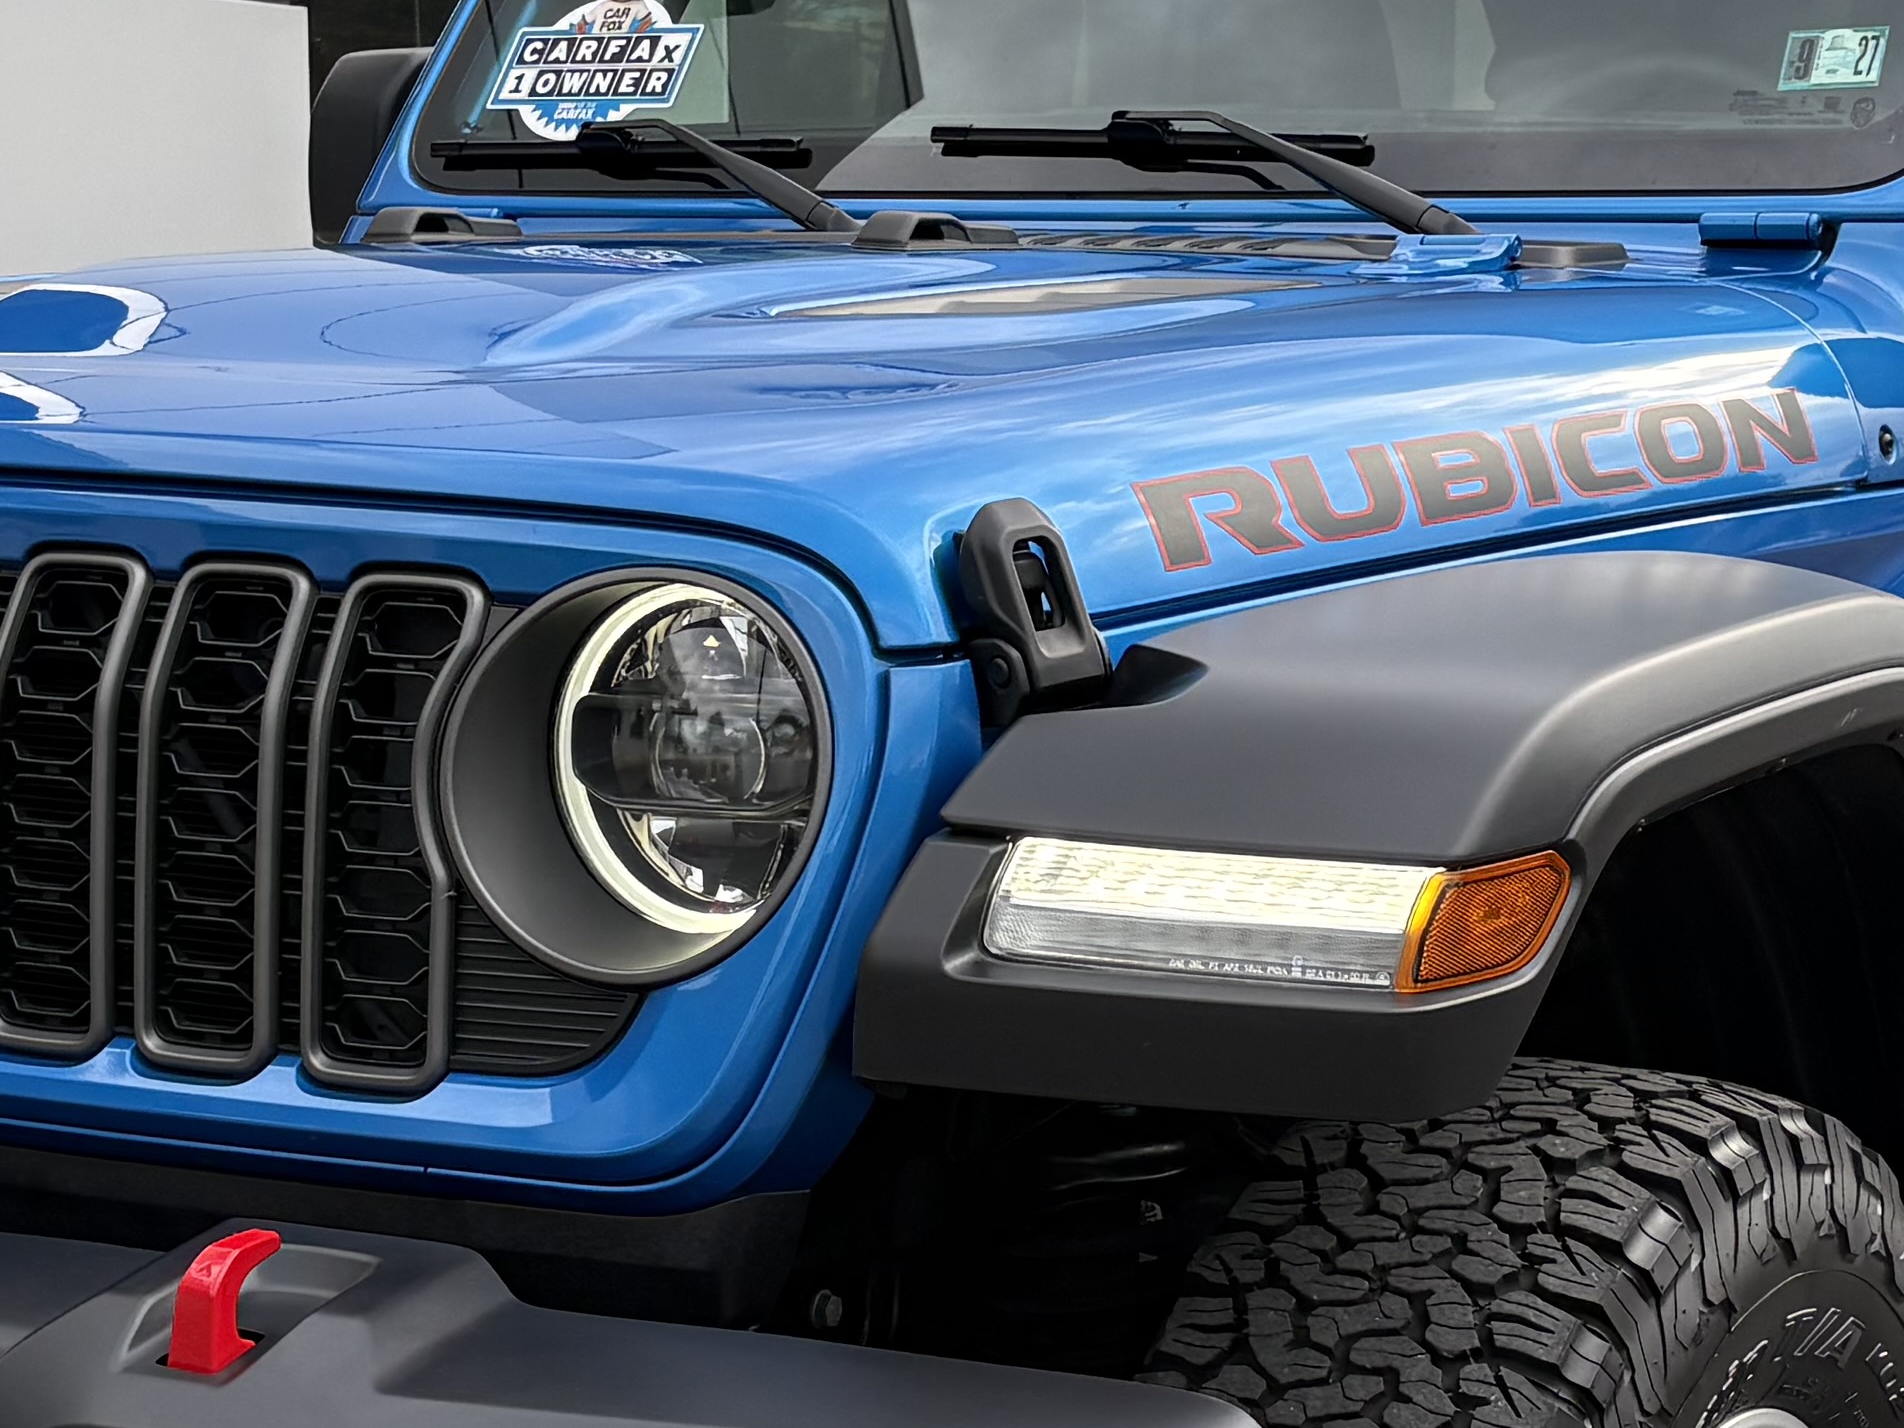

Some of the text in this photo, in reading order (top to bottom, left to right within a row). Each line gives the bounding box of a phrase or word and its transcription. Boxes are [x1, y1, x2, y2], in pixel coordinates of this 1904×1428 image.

[603, 6, 632, 20] CAR
[599, 20, 627, 33] FOX
[523, 38, 682, 64] CARFAX
[1794, 34, 1881, 81] 9 27
[508, 71, 669, 94] 1 OWNER
[1131, 386, 1819, 573] RUBICON
